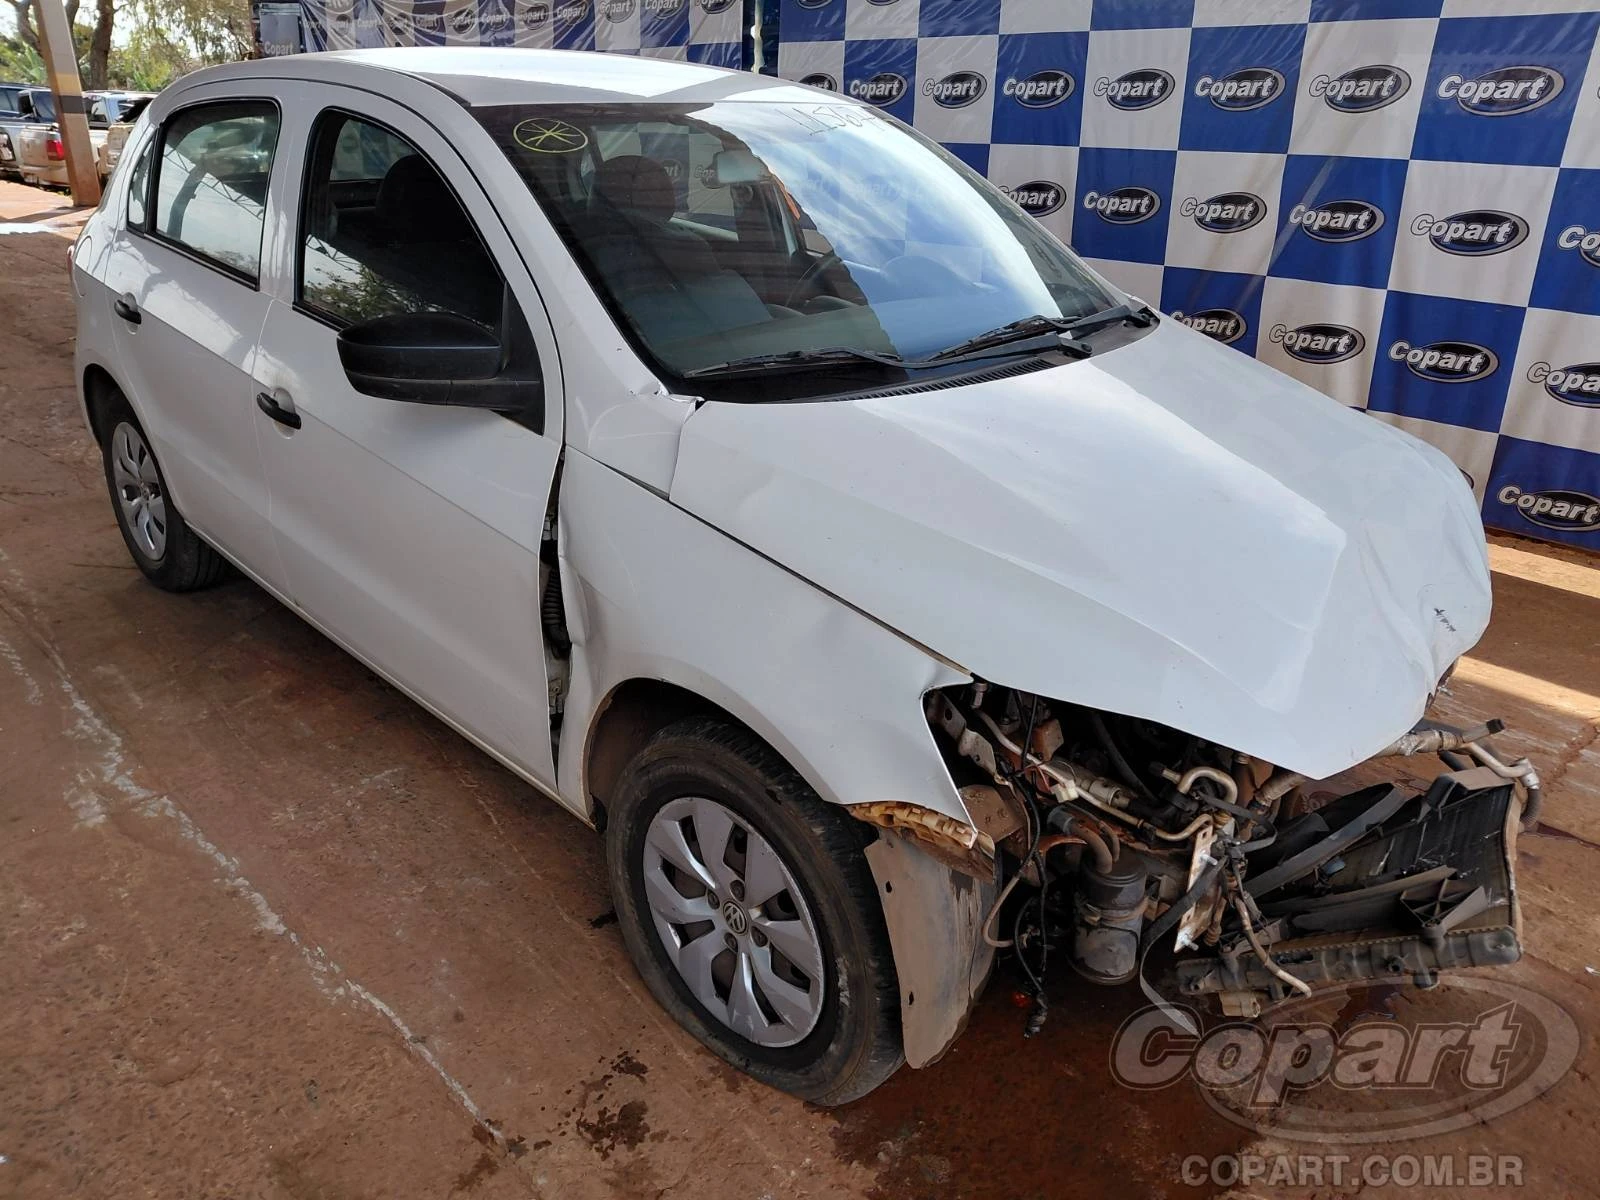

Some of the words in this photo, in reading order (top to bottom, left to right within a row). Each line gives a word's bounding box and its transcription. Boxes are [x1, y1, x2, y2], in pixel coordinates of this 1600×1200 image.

[849, 79, 900, 98] Copart
[922, 78, 978, 100] Copart
[1003, 77, 1067, 100] Copart
[1093, 76, 1165, 101] Copart
[1195, 74, 1276, 102] Copart
[1309, 73, 1398, 103] Copart
[1437, 73, 1549, 105] Copart
[1083, 190, 1151, 215] Copart
[1180, 196, 1255, 223] Copart
[1289, 202, 1372, 232] Copart
[1410, 213, 1515, 244] Copart
[1269, 323, 1352, 355] Copart
[1388, 339, 1486, 375] Copart
[1527, 361, 1600, 394] Copa
[1498, 485, 1600, 524] Copart
